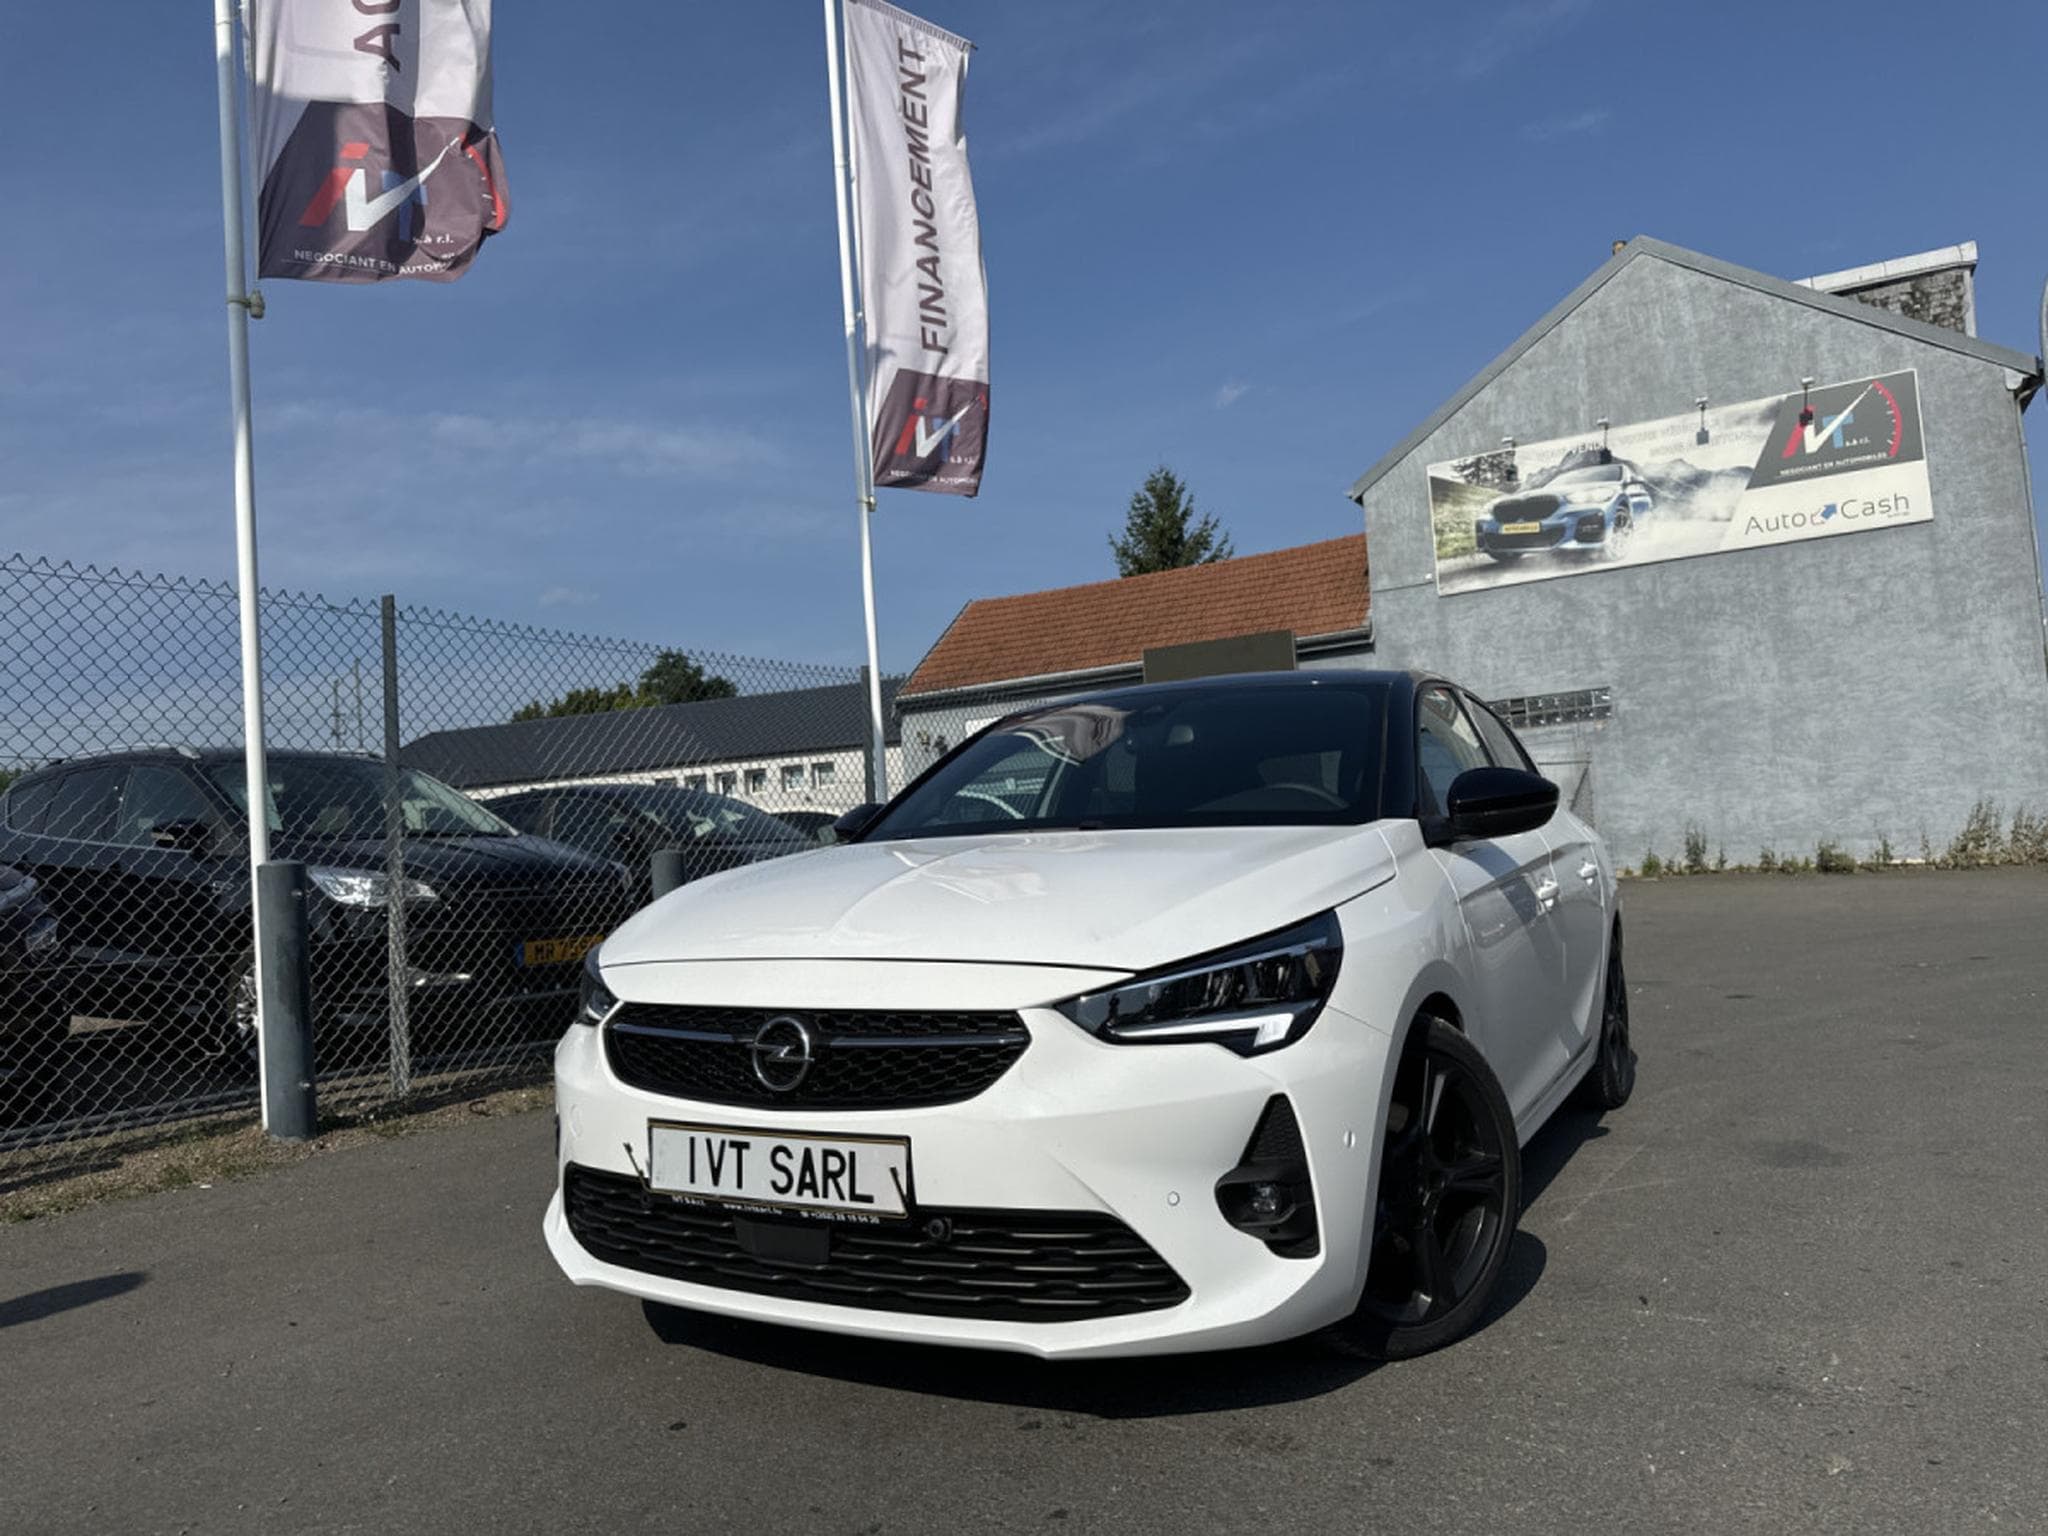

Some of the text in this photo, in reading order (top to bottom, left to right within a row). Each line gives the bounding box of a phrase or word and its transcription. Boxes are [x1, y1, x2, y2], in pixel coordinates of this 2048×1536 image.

[899, 38, 948, 355] FINANCEMENT
[294, 250, 376, 269] NEGOCIANT
[1744, 493, 1910, 535] Auto Cash
[688, 1136, 875, 1204] IVT SARL
